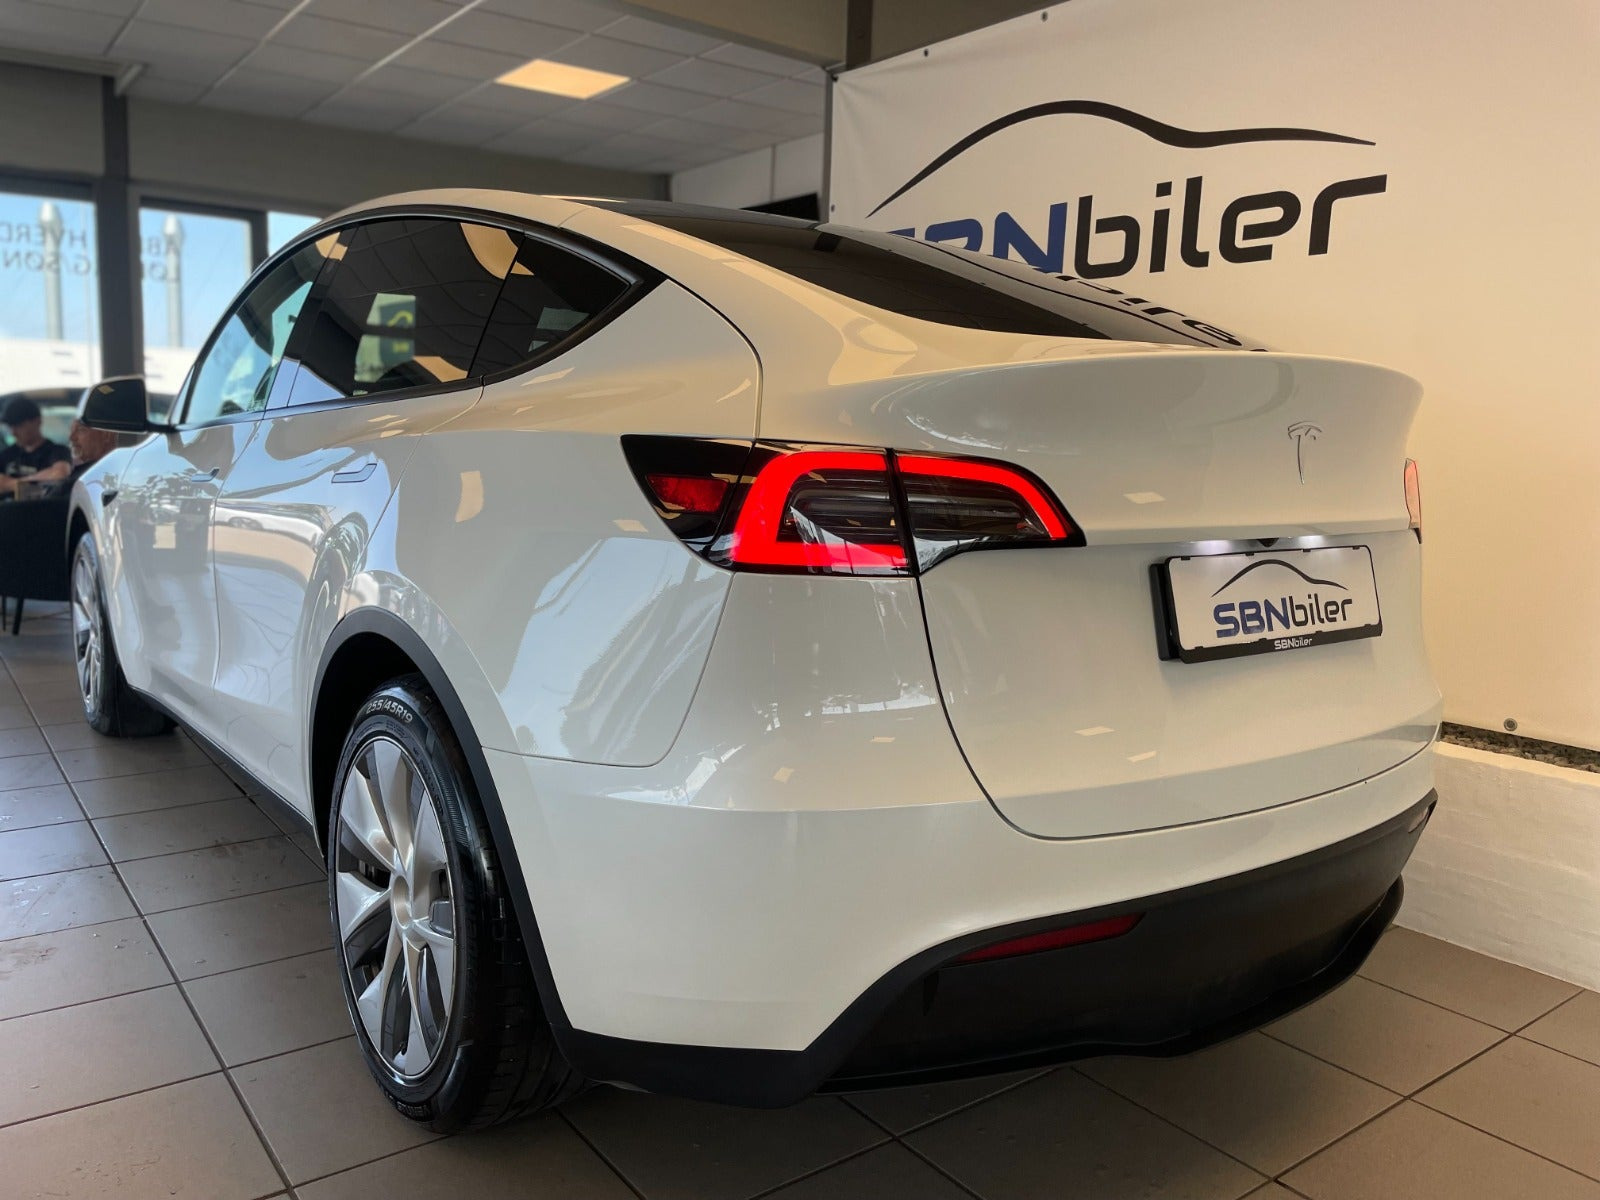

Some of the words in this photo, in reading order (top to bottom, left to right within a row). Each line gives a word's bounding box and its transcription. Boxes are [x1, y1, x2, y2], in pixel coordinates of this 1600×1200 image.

[1213, 594, 1352, 638] SBNbiler
[1274, 638, 1312, 650] SBNbiler
[366, 698, 413, 723] 255/45R19
